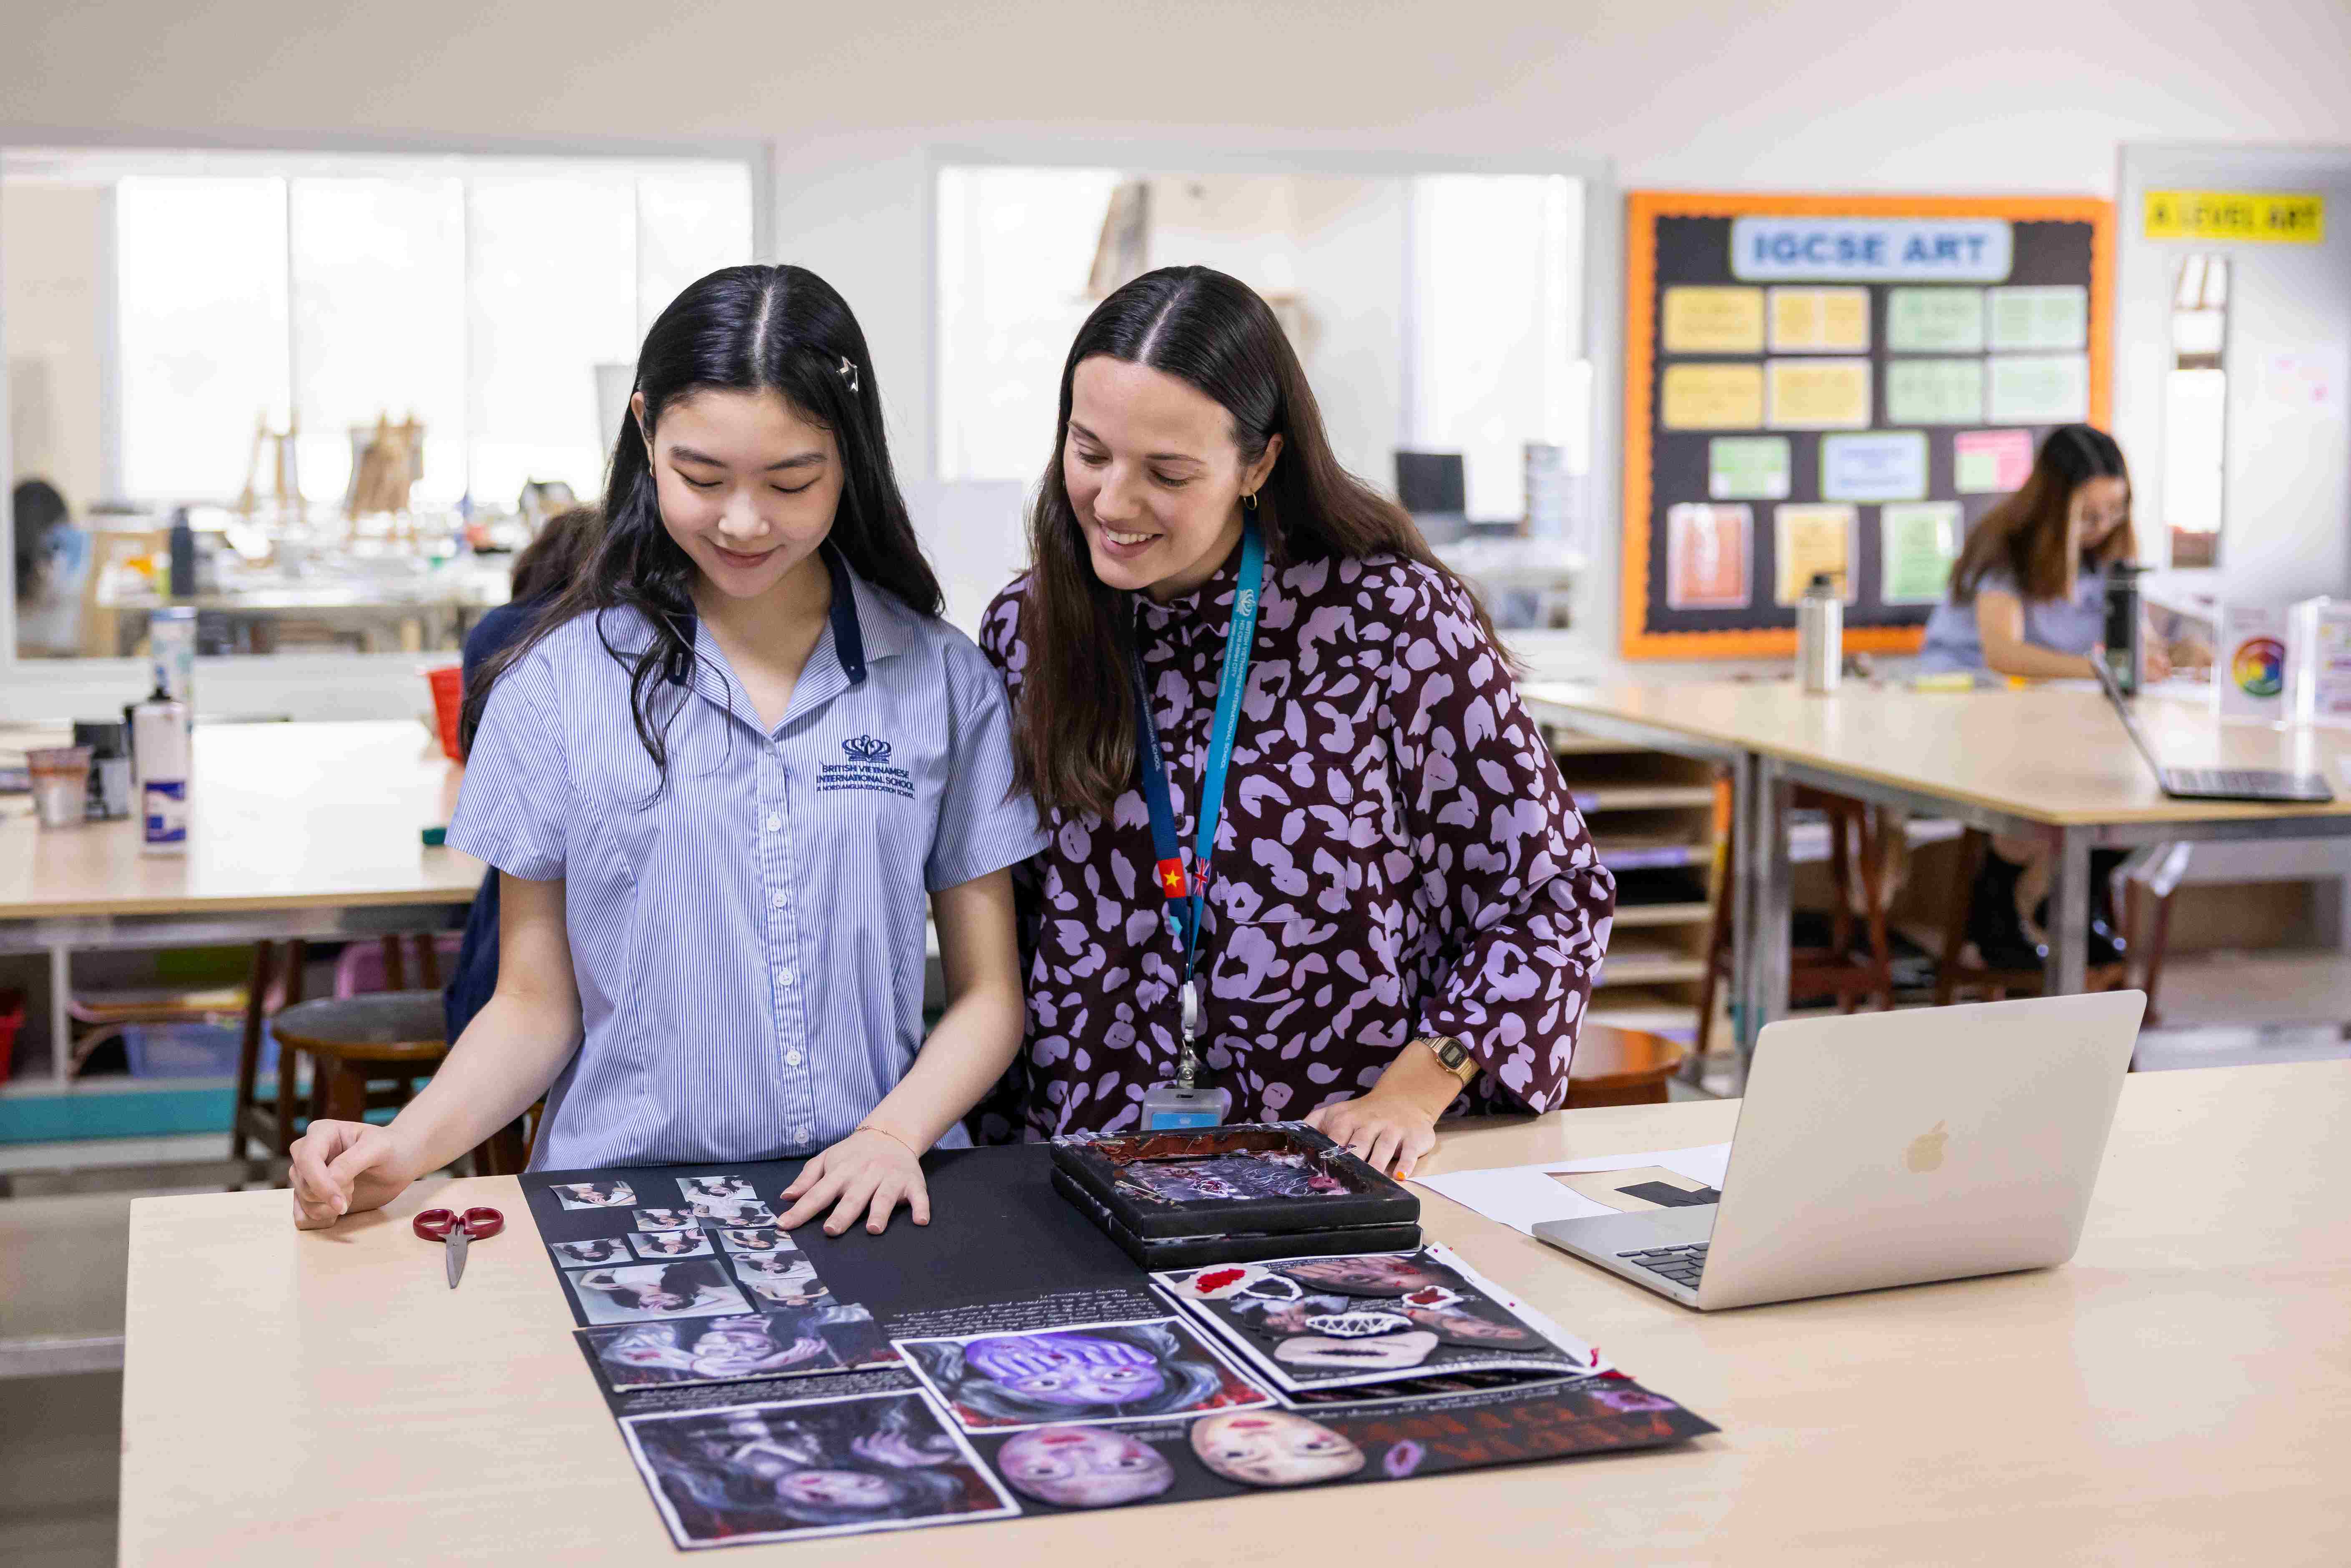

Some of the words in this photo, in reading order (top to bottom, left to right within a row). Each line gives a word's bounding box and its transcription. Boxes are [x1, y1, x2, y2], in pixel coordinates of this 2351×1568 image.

[2268, 204, 2320, 232] ART
[1754, 232, 1886, 266] IGCSE
[1903, 233, 1987, 266] ART
[1151, 744, 1160, 771] SCHOOL
[1219, 742, 1230, 770] SCHOOL
[816, 774, 885, 784] INTERNATIONAL
[885, 777, 914, 791] SCHOOL
[858, 765, 910, 779] VIETNAMESE
[865, 784, 896, 794] EDUCATION
[897, 789, 915, 800] SCHOOL
